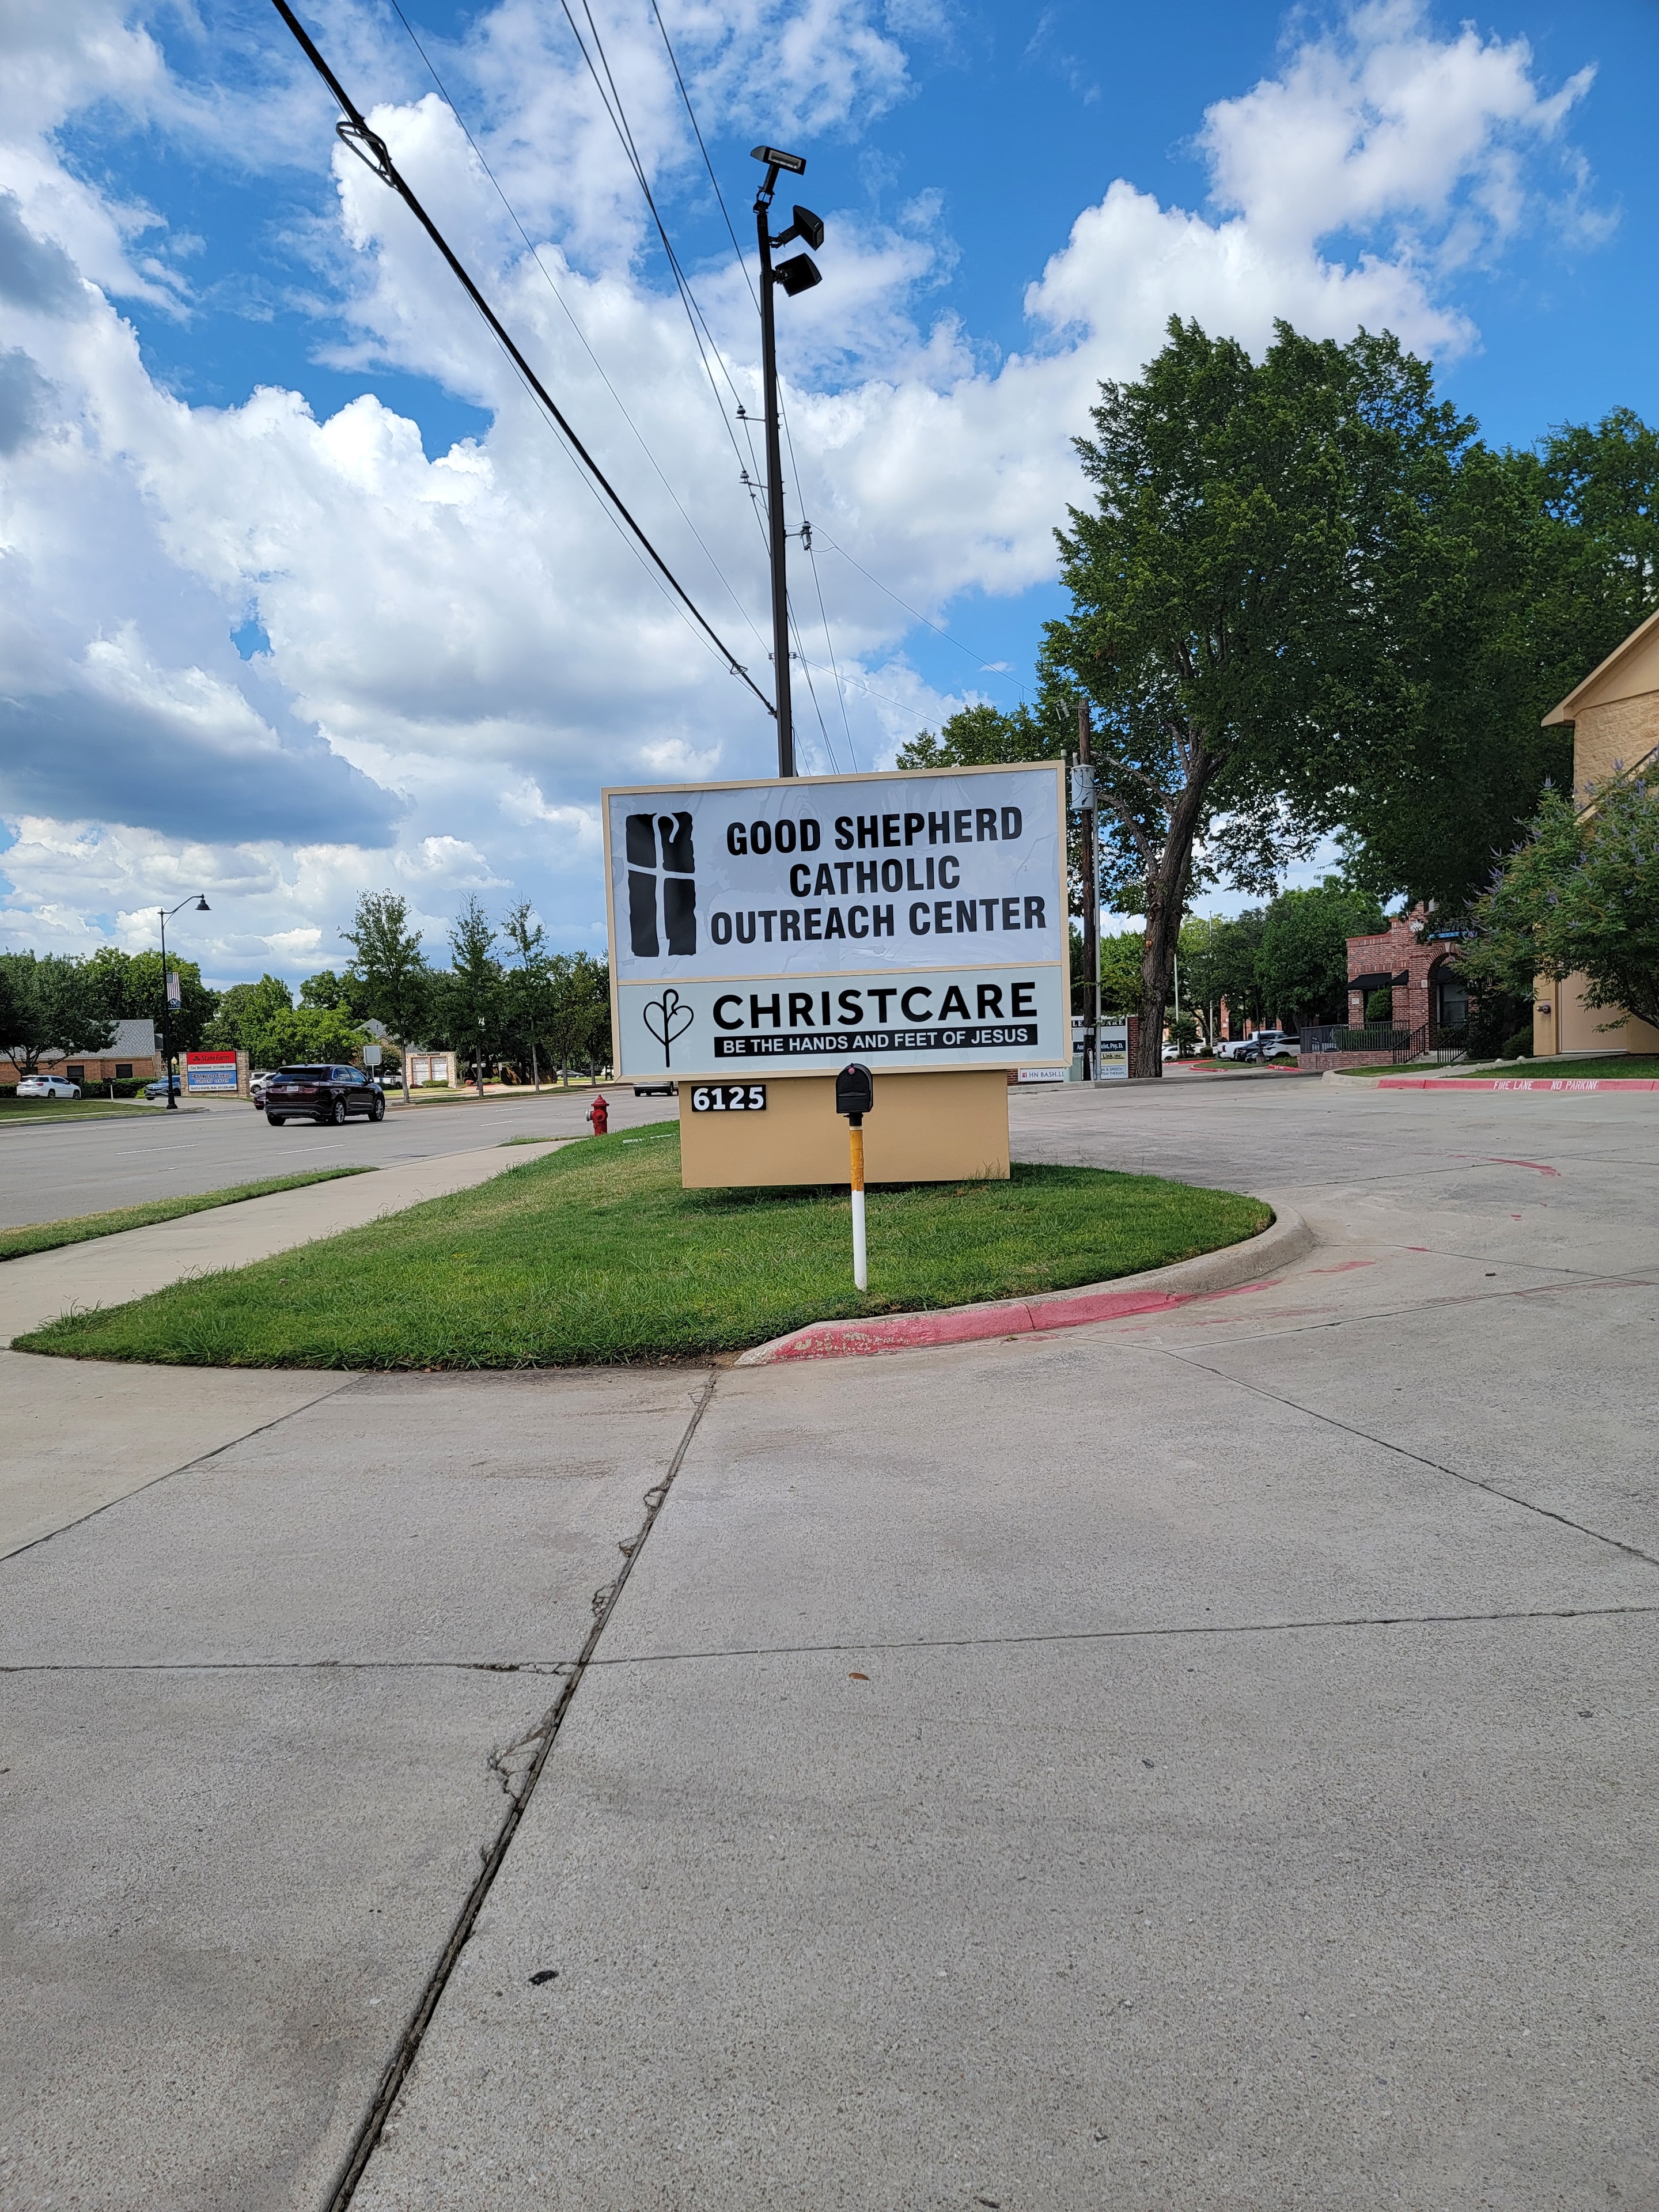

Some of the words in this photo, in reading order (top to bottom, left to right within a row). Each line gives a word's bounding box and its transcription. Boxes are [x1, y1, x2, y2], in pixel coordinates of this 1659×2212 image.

[727, 819, 821, 856] GOOD
[835, 806, 1022, 851] SHEPHERD
[790, 855, 960, 897] CATHOLIC
[711, 904, 895, 945] OUTREACH
[909, 896, 1047, 935] CENTER
[713, 982, 1037, 1031] CHRISTCARE
[724, 1040, 746, 1054] BE
[751, 1038, 784, 1052] THE
[789, 1036, 849, 1051] HANDS
[853, 1034, 889, 1048] AND
[895, 1032, 938, 1047] FEET
[942, 1031, 966, 1045] OF
[971, 1028, 1028, 1044] JESUS
[694, 1086, 764, 1110] 6125
[1493, 1081, 1511, 1090] FIRE
[1513, 1081, 1534, 1090] LANE
[1550, 1081, 1563, 1090] NO
